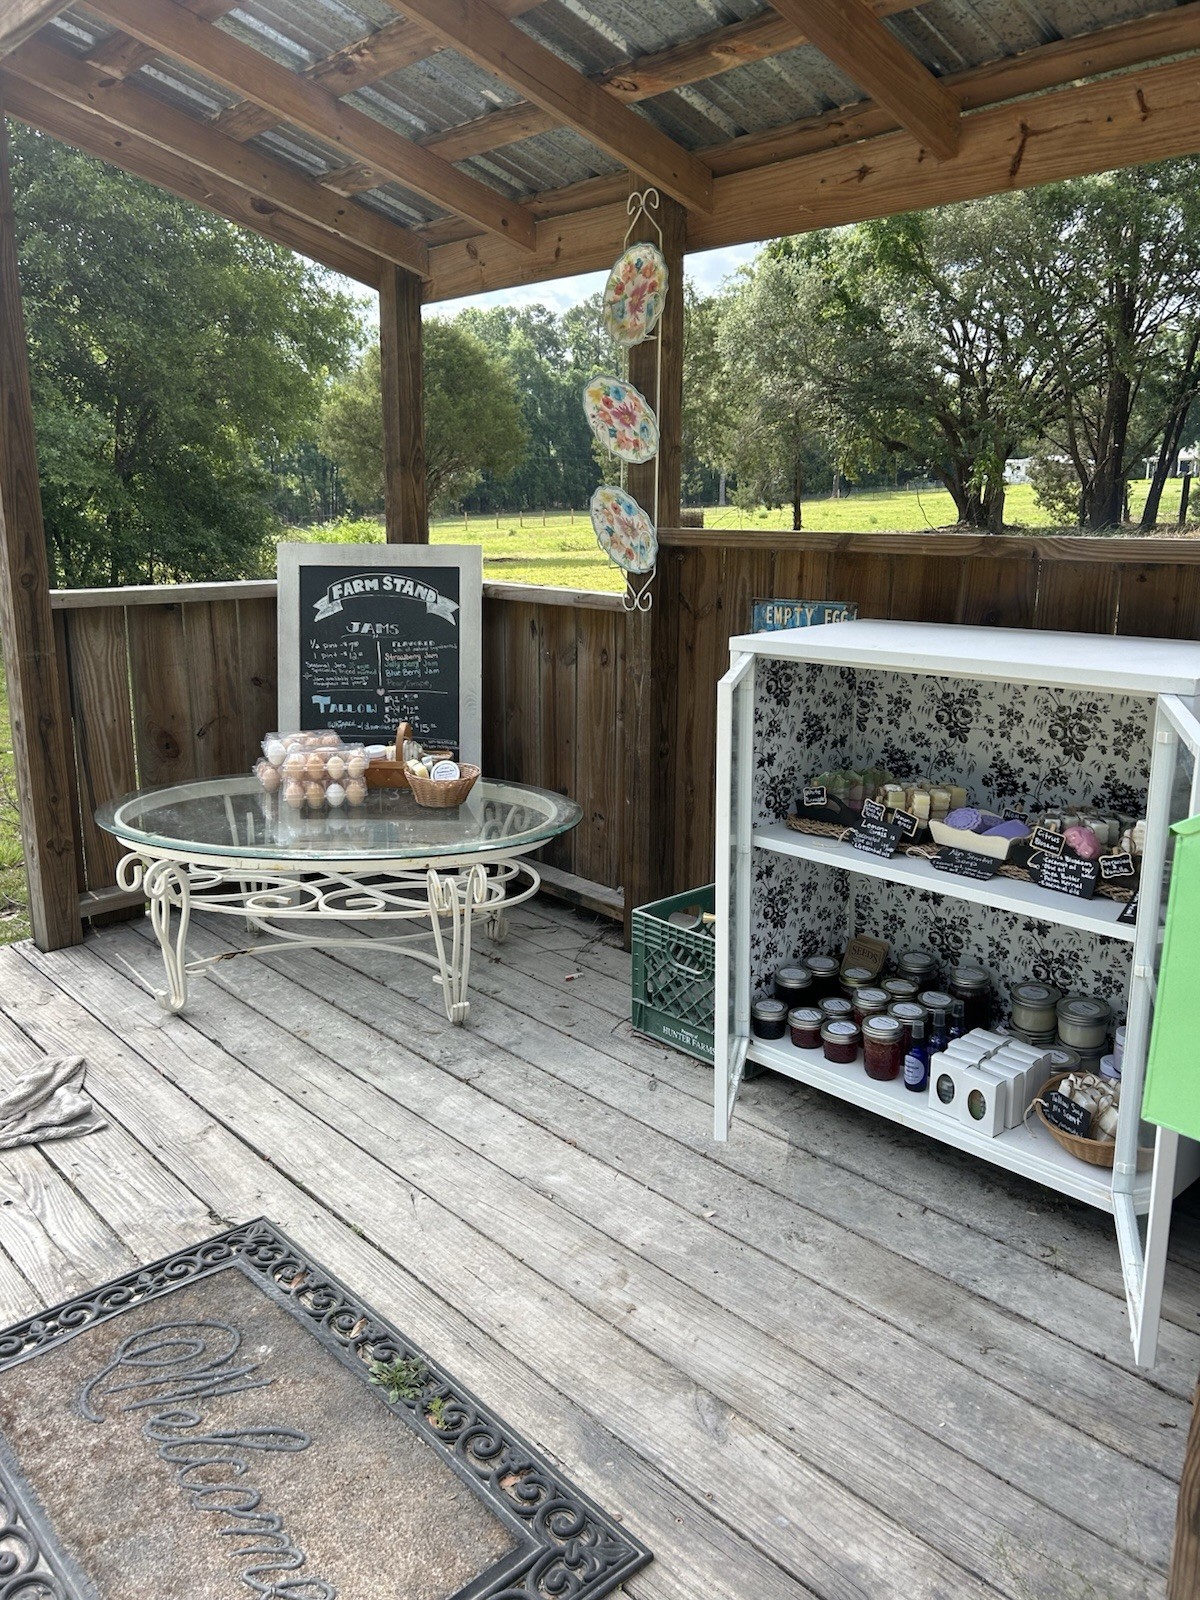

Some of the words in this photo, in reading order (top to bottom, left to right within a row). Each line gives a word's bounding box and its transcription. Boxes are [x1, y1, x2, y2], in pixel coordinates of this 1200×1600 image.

[332, 578, 380, 600] FARM
[382, 576, 437, 603] STAND
[766, 605, 815, 626] EMPTY
[345, 621, 400, 635] JAMS
[423, 651, 440, 660] Jam
[385, 668, 401, 678] Blue
[424, 666, 441, 675] Jam
[1036, 829, 1061, 844] Citrus
[851, 944, 880, 964] SEEDS
[662, 1025, 692, 1046] HUNTER
[78, 1319, 336, 1600] Welcome
